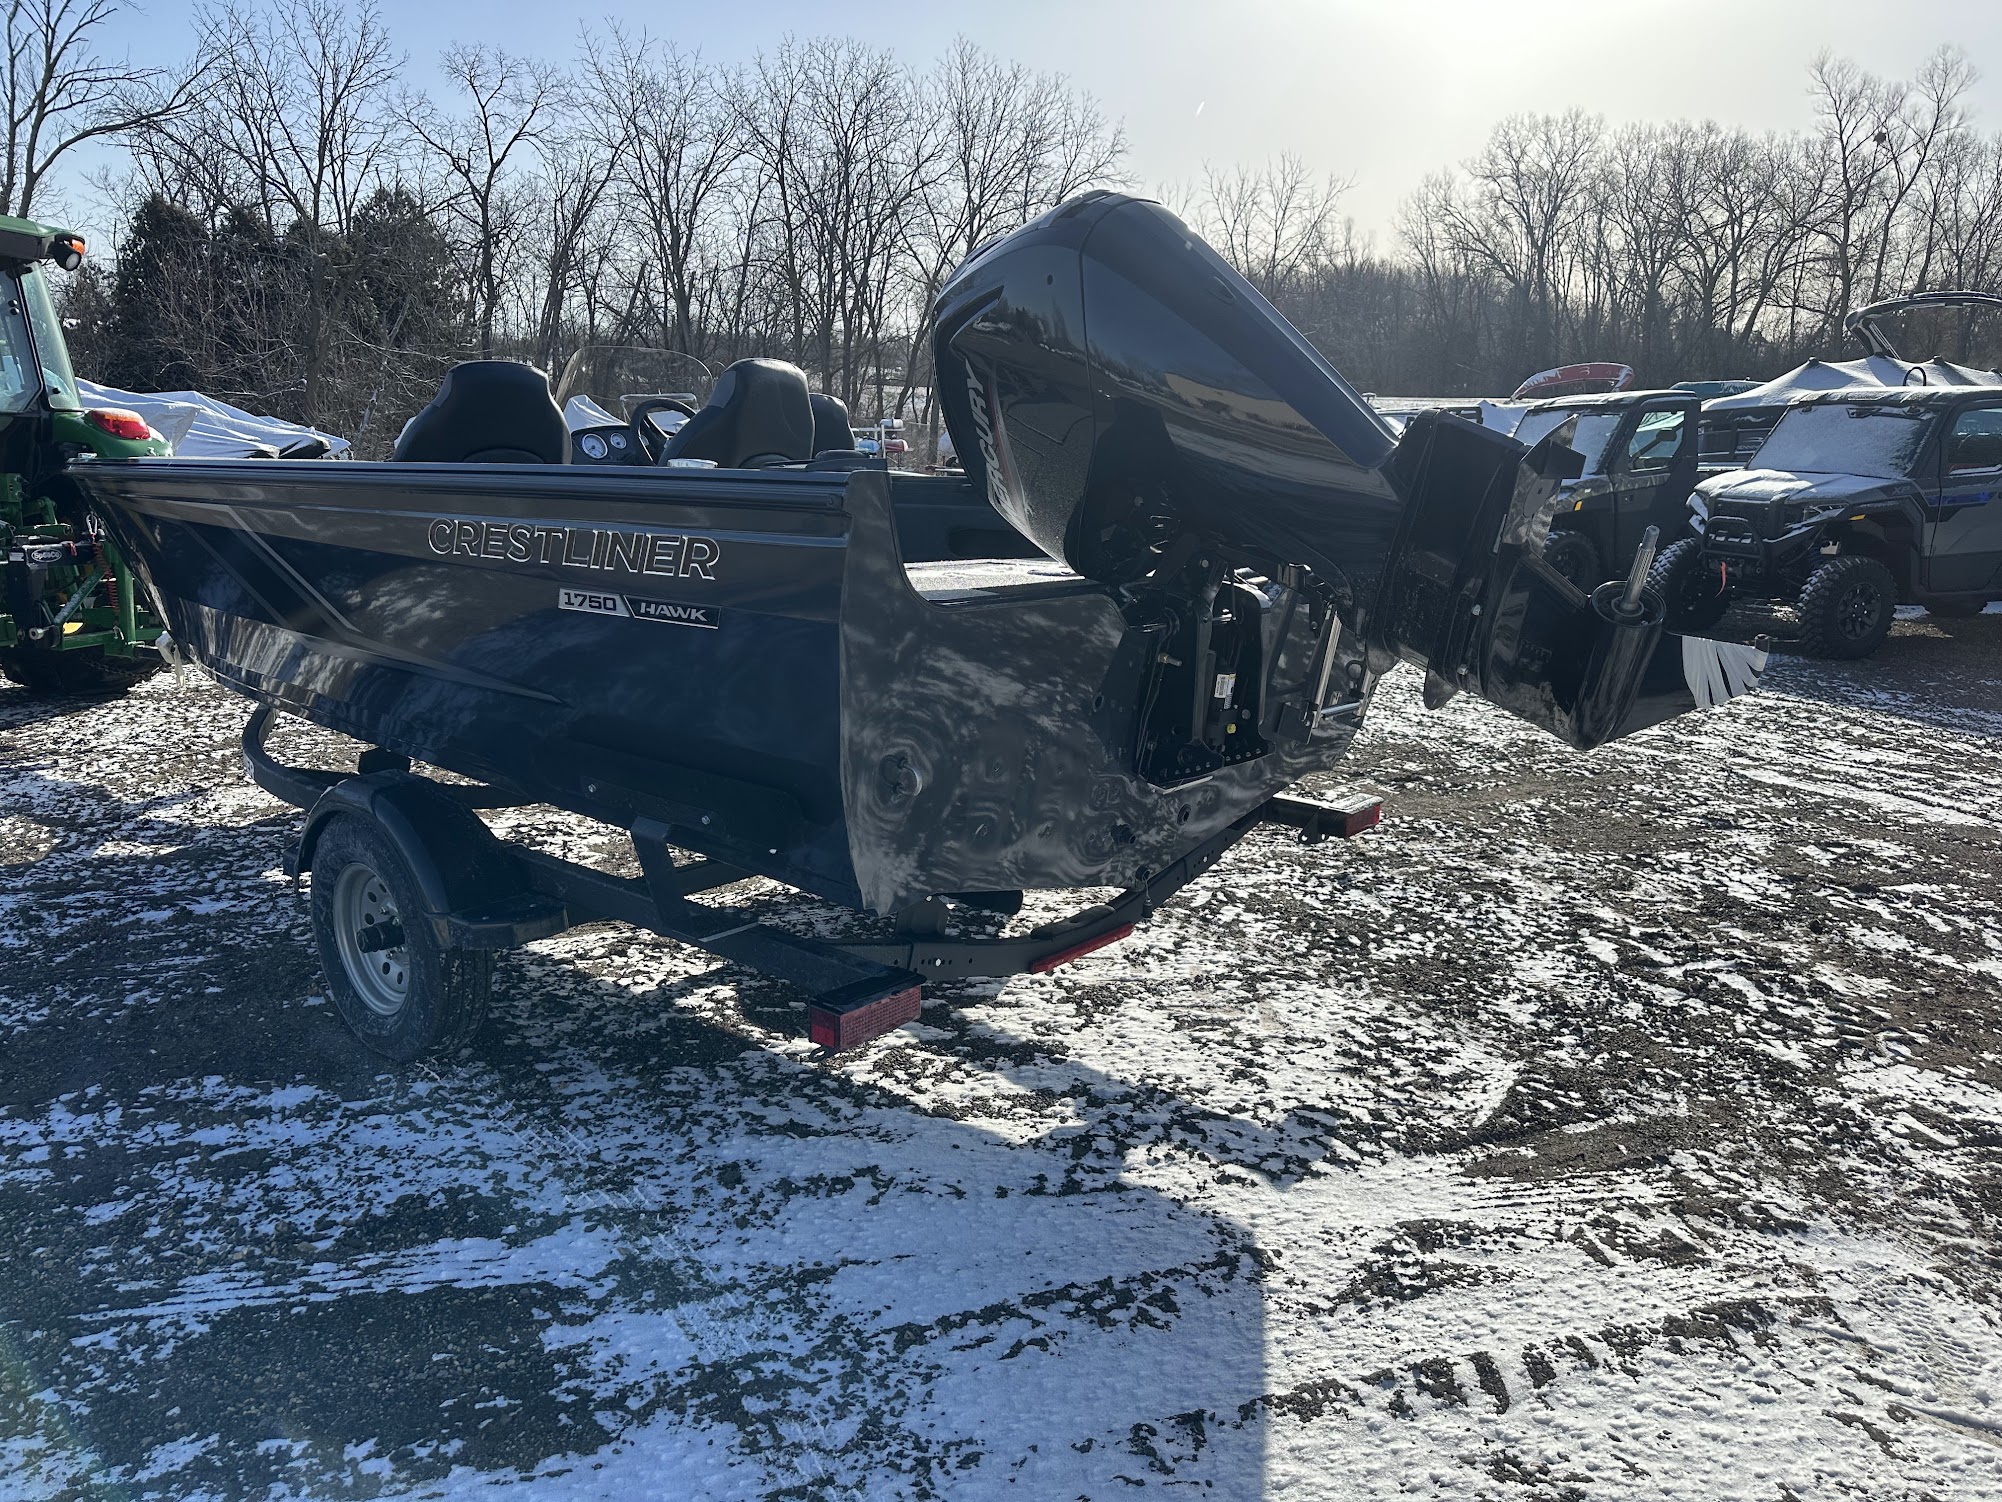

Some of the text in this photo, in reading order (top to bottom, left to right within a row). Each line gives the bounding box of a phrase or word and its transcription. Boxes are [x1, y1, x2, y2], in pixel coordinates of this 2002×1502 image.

[428, 518, 720, 580] CRESTLINER
[563, 592, 707, 622] 1750 HAWK
